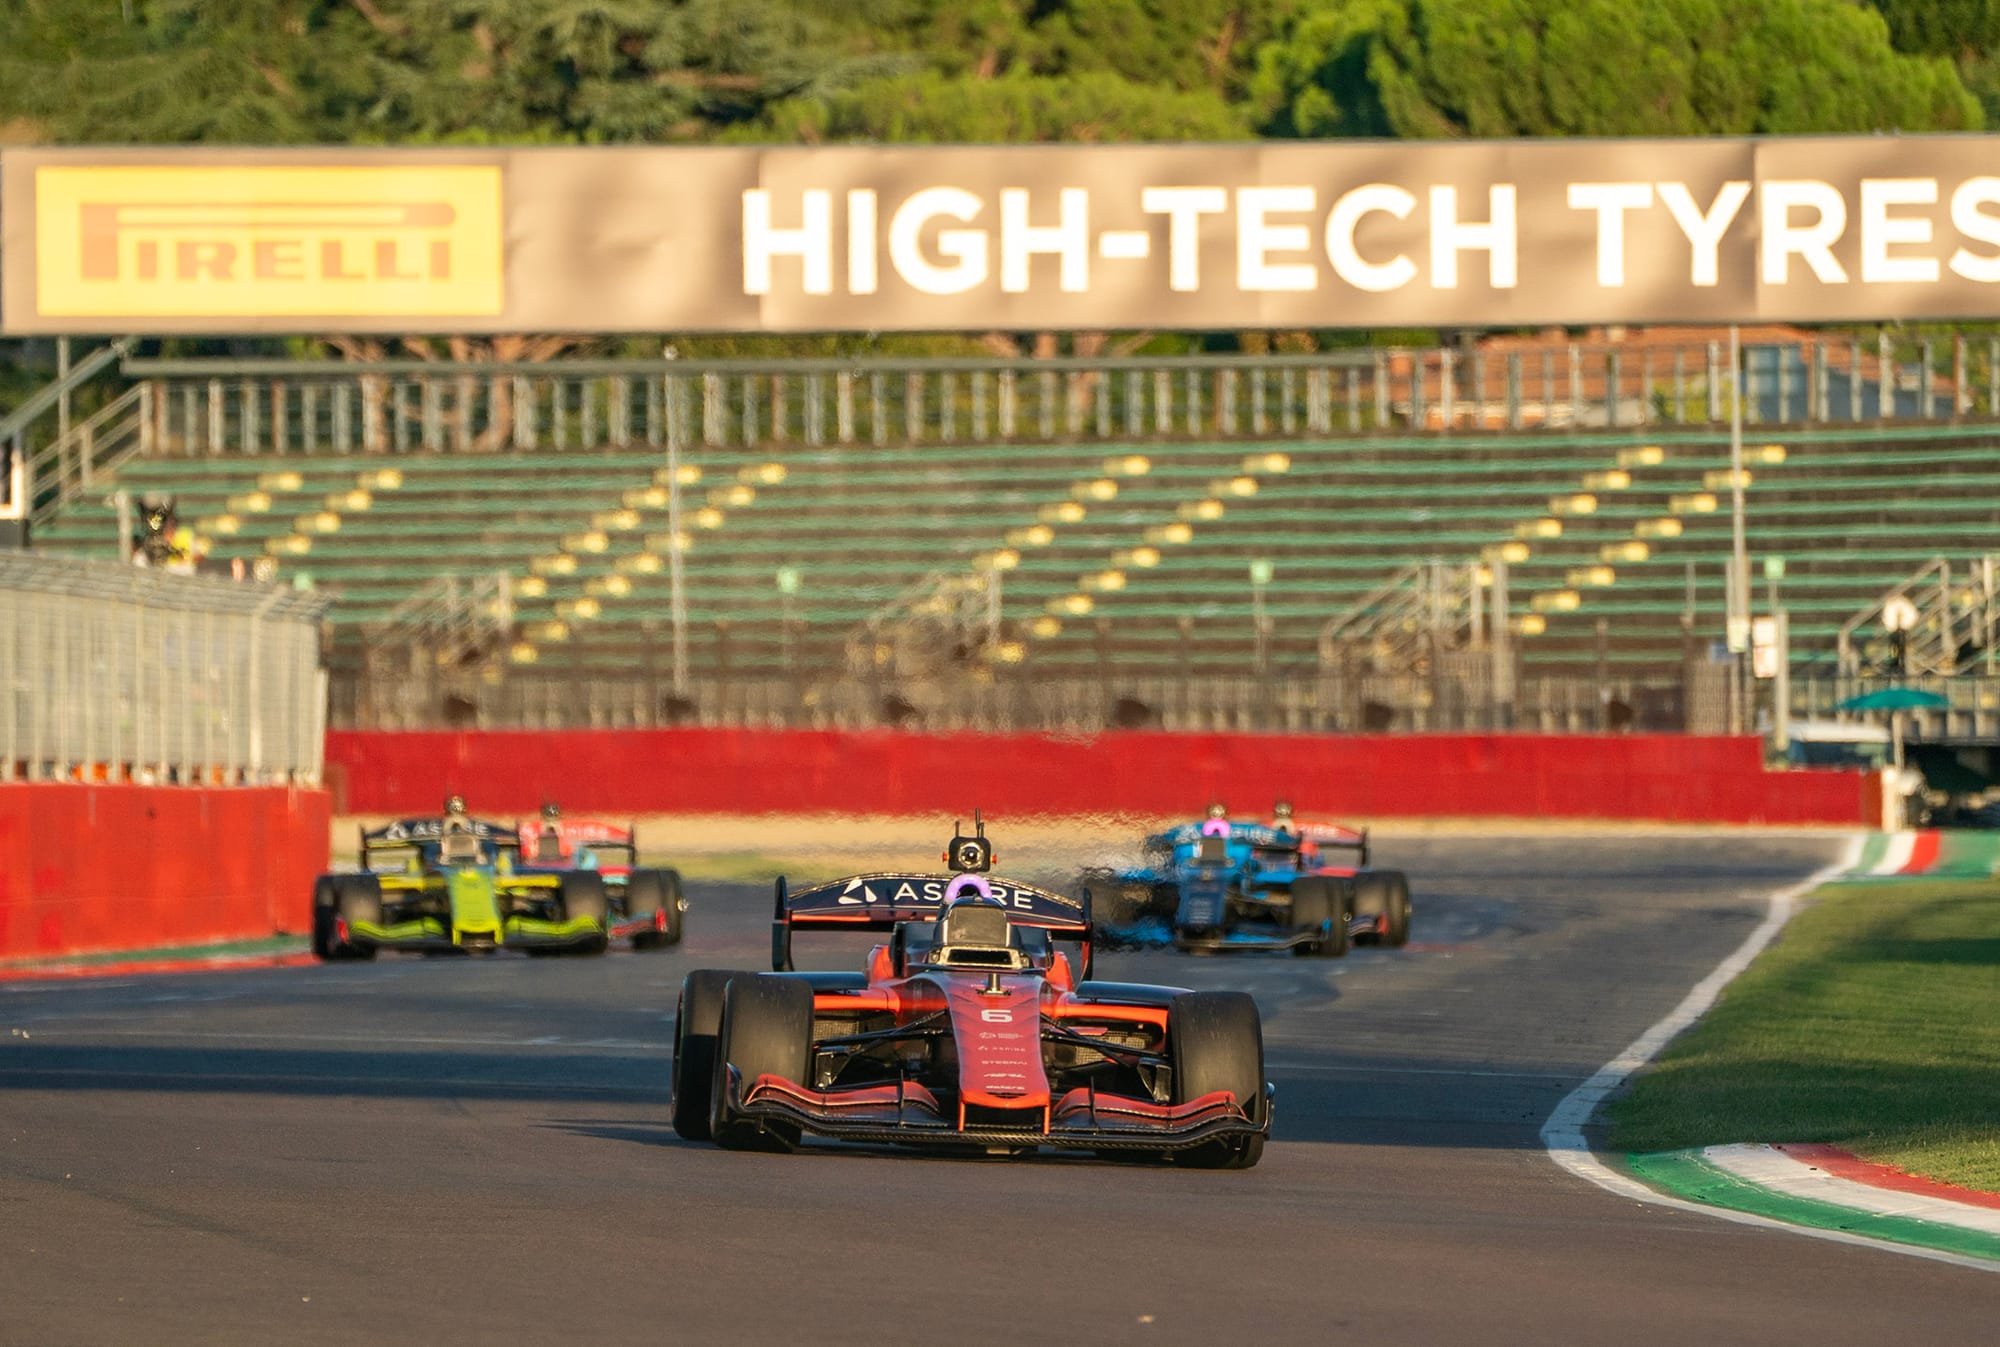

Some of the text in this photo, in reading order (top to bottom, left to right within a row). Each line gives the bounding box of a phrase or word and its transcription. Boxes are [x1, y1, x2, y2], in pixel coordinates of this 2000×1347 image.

[80, 201, 456, 281] PIRELLI
[742, 176, 2000, 294] HIGH-TECH TYRES
[894, 882, 1034, 910] ASRE
[981, 1009, 1013, 1023] 6
